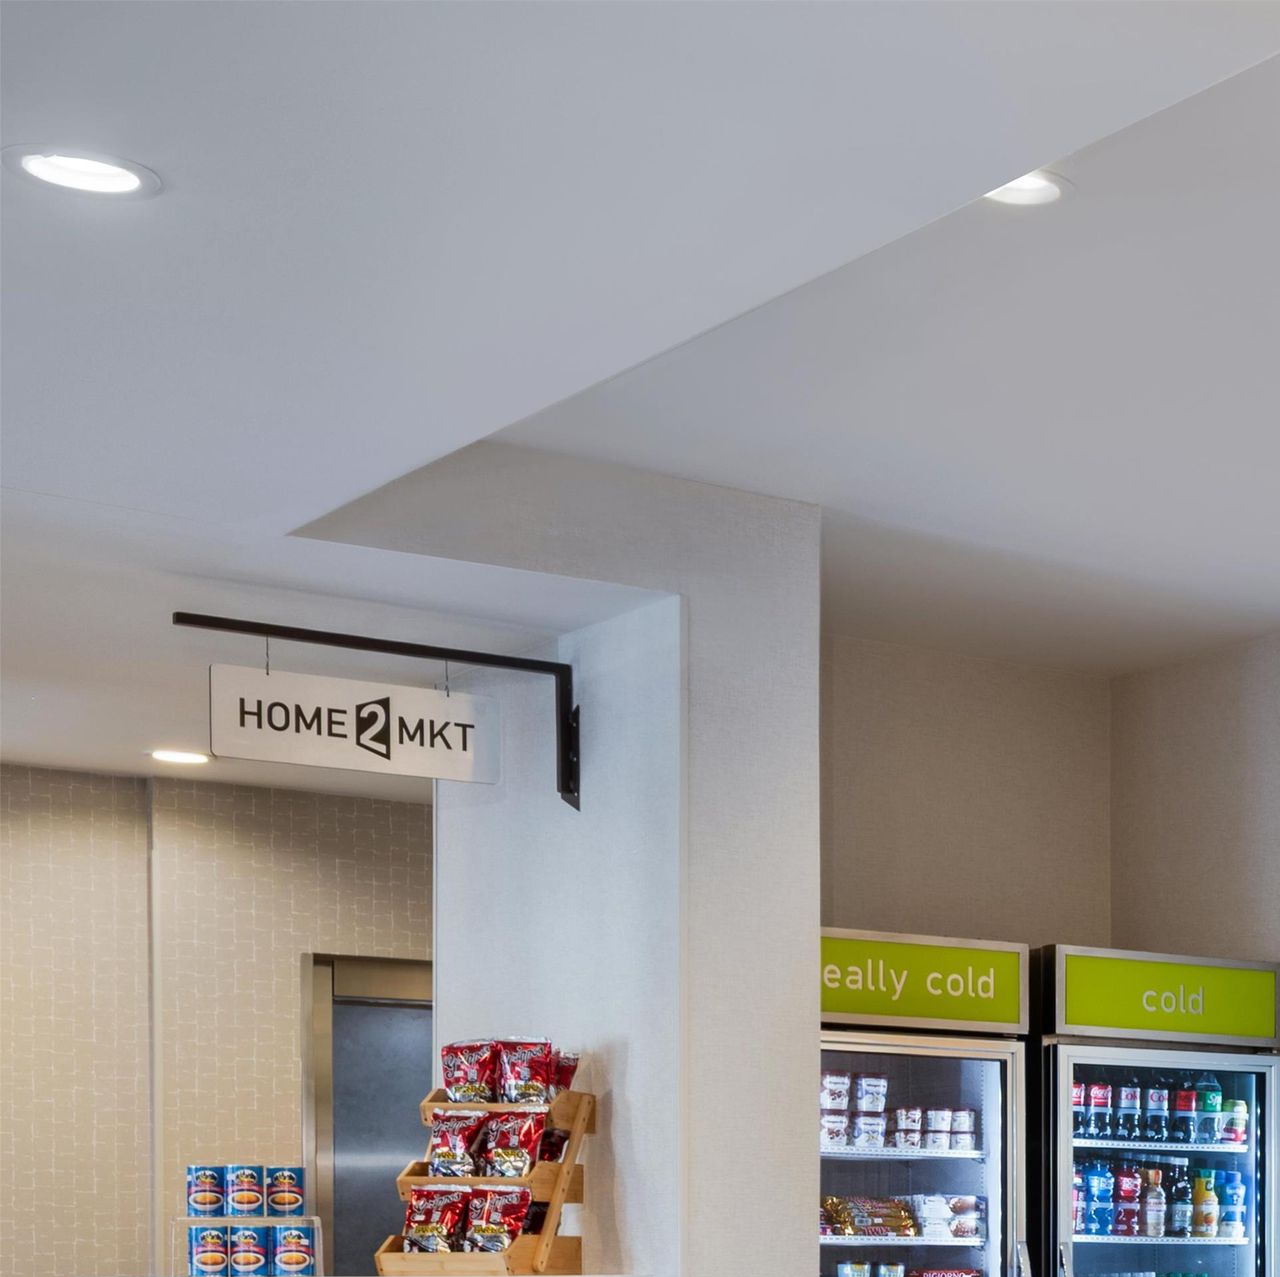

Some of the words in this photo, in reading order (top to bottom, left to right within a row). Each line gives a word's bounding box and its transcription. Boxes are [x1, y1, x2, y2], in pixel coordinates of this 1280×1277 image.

[398, 716, 475, 751] MKT
[822, 958, 908, 1001] eally
[926, 967, 996, 999] cold
[1142, 985, 1205, 1016] cold
